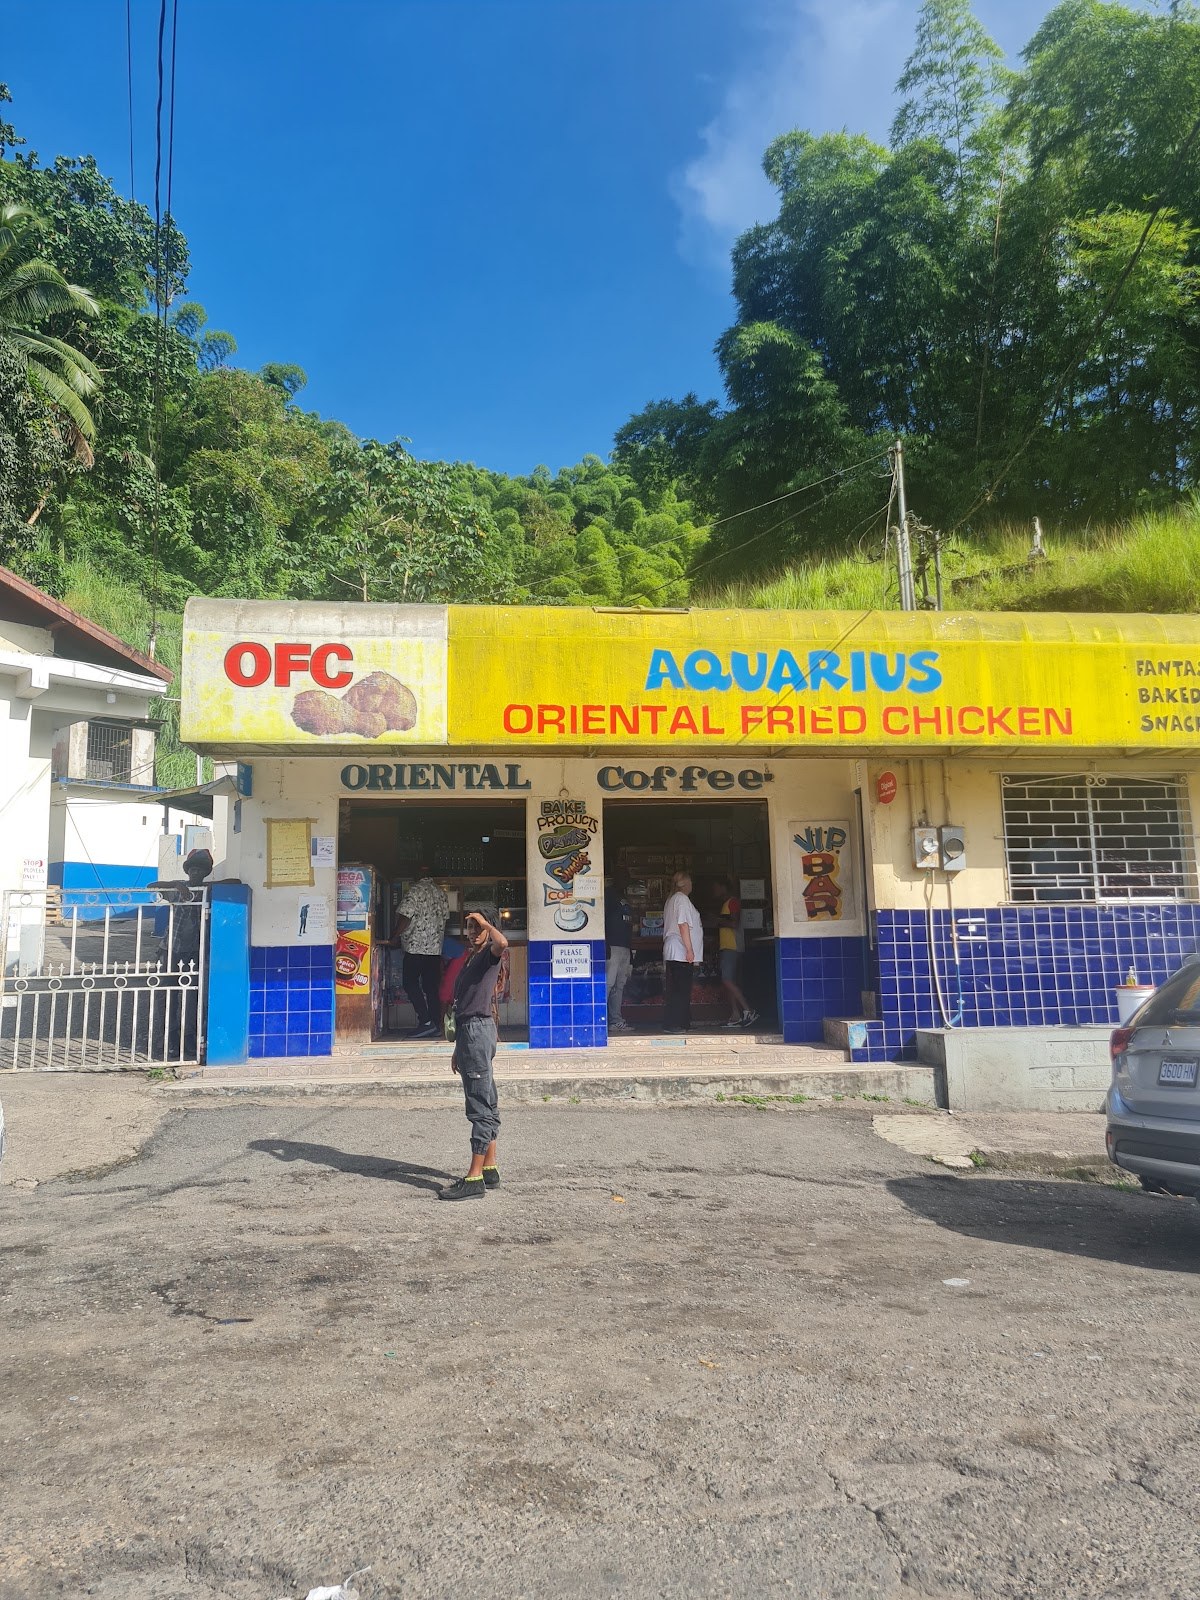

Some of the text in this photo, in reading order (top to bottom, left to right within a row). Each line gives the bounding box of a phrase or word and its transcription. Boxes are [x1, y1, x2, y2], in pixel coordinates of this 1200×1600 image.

[223, 641, 354, 689] OFC
[645, 648, 942, 694] AQUARIUS
[1135, 659, 1200, 677] FANTA
[1137, 686, 1200, 704] BAKED
[503, 704, 1074, 736] ORIENTAL FRIED CHICKEN
[340, 763, 532, 791] ORIENTAL
[596, 765, 763, 791] Coffee
[541, 800, 586, 816] BAKE
[537, 814, 599, 834] PRODUCTS
[802, 853, 841, 919] BAR
[548, 892, 573, 900] COF
[338, 958, 355, 969] Spice
[555, 957, 573, 965] WATCH
[1161, 1063, 1183, 1079] 3600
